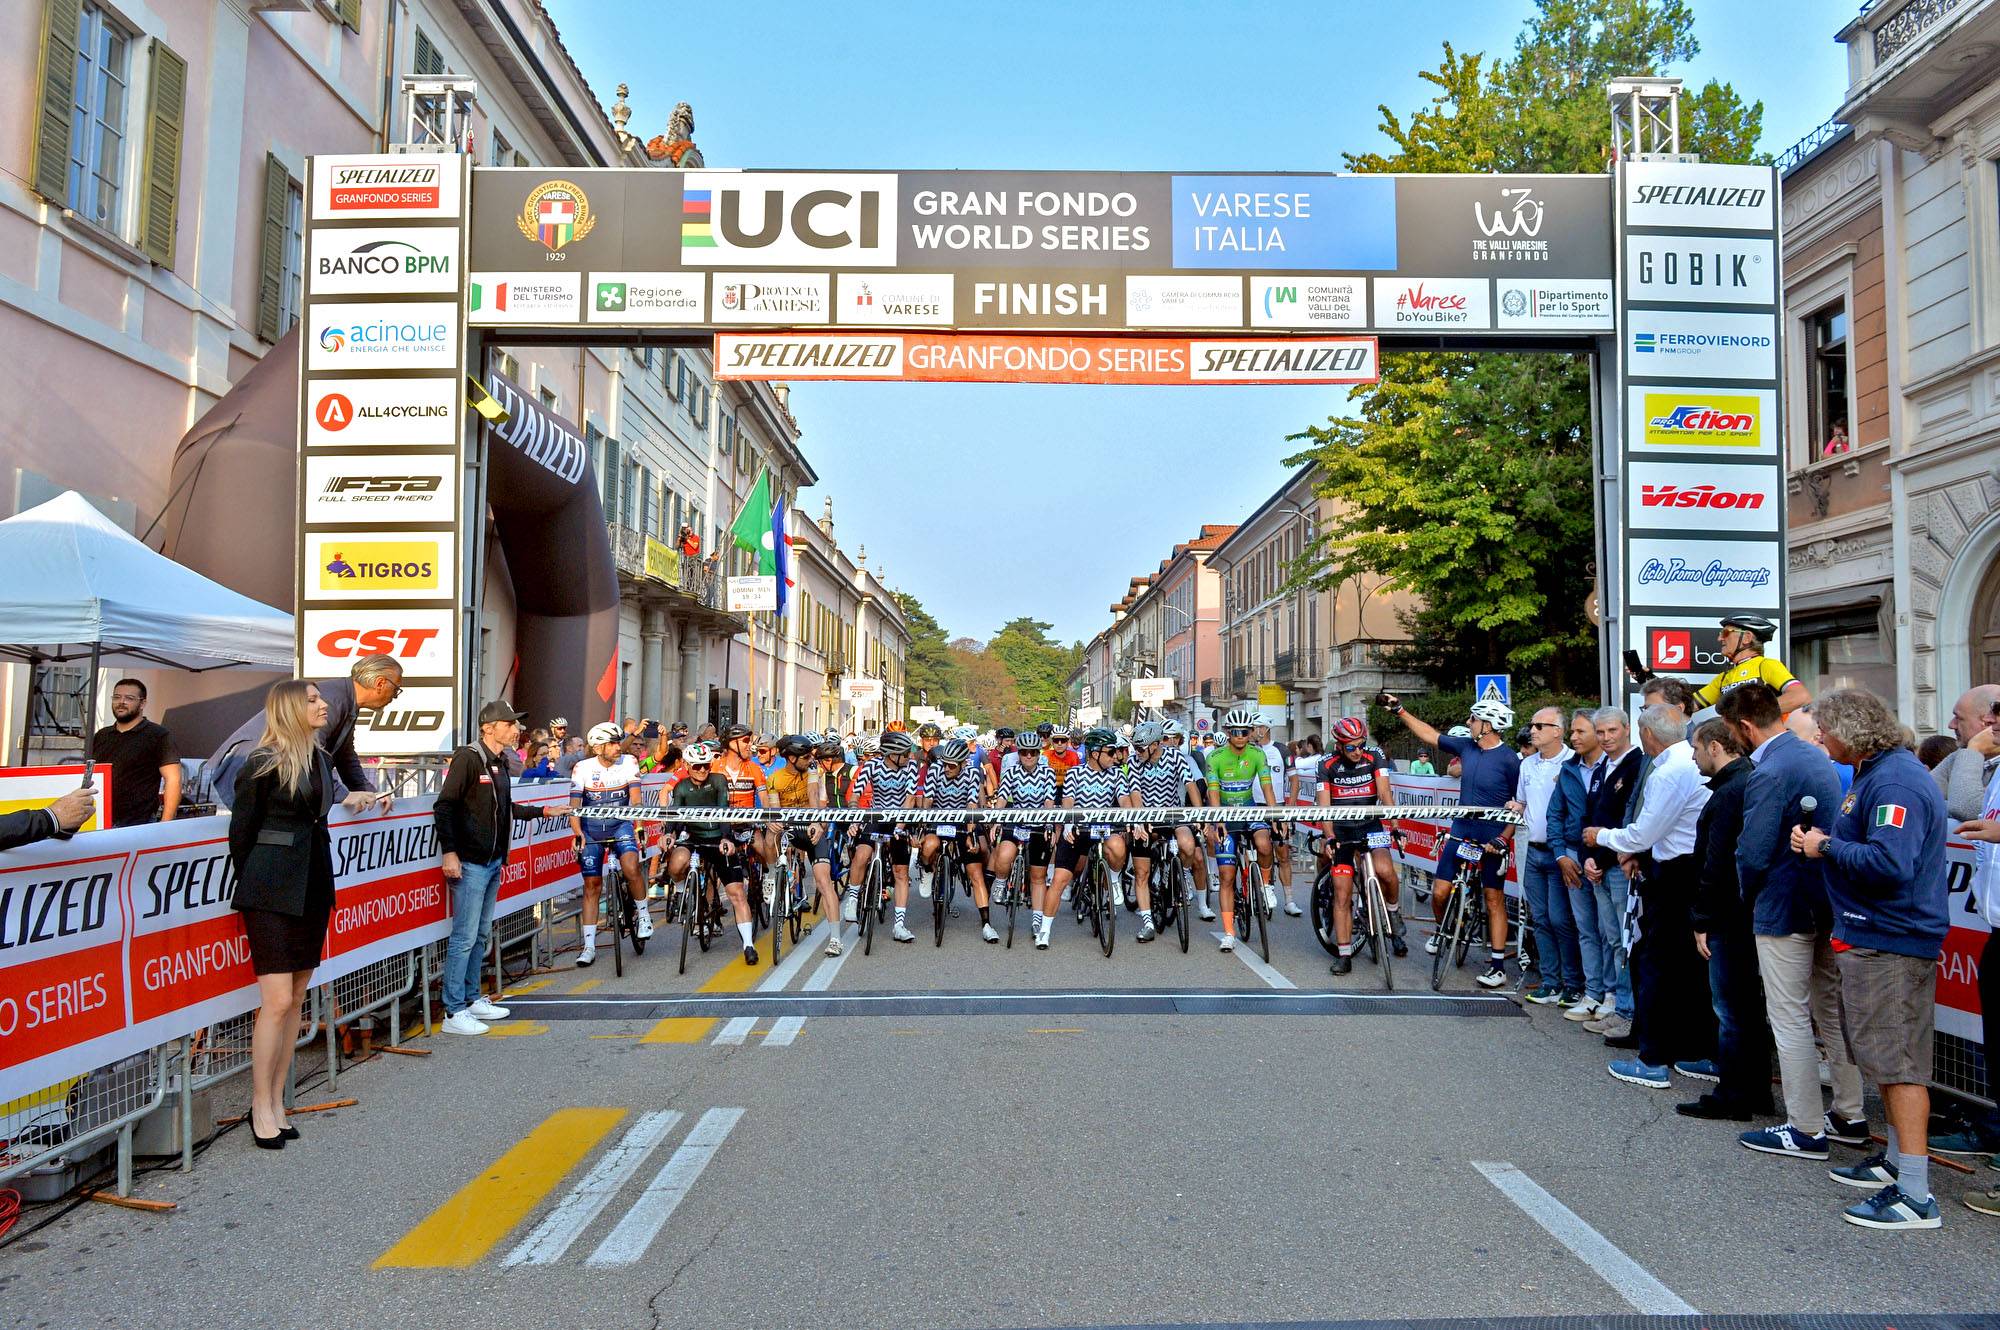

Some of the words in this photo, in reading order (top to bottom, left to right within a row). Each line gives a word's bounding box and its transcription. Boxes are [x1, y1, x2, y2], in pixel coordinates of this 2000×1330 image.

[335, 168, 435, 185] SPECIALIZED
[335, 193, 399, 204] GRANFONDO
[401, 192, 432, 203] SERIES
[543, 192, 571, 200] VARESE
[912, 191, 1013, 217] GRAN
[1018, 192, 1138, 217] FONDO
[1632, 185, 1766, 208] SPECIALIZED
[1192, 192, 1311, 219] VARESE
[720, 189, 880, 249] UCI
[912, 225, 1034, 251] WORLD
[1040, 225, 1151, 251] SERIES
[1193, 226, 1286, 252] ITALIA
[1473, 240, 1487, 250] TRE
[1489, 240, 1510, 250] VALLI
[1512, 240, 1548, 250] VARESINE
[545, 252, 566, 261] 1929
[1473, 251, 1549, 260] GRANFONDO
[319, 256, 399, 275] BANCO
[405, 256, 449, 274] BPM
[1639, 251, 1748, 287] GOBIK
[513, 293, 531, 301] DEL
[533, 293, 573, 301] TURISMO
[630, 287, 682, 299] Regione
[974, 283, 1108, 316] FINISH
[1396, 282, 1467, 310] #Varese
[1539, 290, 1609, 301] Dipartimento
[629, 298, 697, 308] Lombardia
[761, 299, 820, 312] VARESE
[883, 304, 940, 315] VARESE
[1539, 302, 1557, 312] per
[1559, 301, 1569, 311] lo
[1571, 301, 1601, 312] Sport
[350, 319, 447, 343] acinque
[350, 345, 388, 353] ENERGIA
[391, 345, 411, 353] CHE
[414, 344, 447, 352] UNISCE
[1660, 333, 1771, 347] FERROVIENORD
[727, 343, 896, 368] SPECIALIZED
[908, 345, 1091, 372] GRANFONDO
[1097, 348, 1185, 373] SERIES
[1198, 348, 1368, 372] SPECIALIZED
[358, 405, 448, 418] ALL4CYCLING
[318, 495, 346, 503] FULL
[351, 494, 390, 502] SPEED
[394, 494, 433, 502] AHEAD
[358, 562, 432, 578] TIGROS
[1638, 558, 1665, 585] Ciclo
[1664, 558, 1702, 583] Promo
[1702, 559, 1771, 588] Components
[316, 628, 440, 658] CST
[1333, 773, 1372, 785] CASSINIS
[676, 807, 764, 821] SPECIALIZED
[777, 808, 865, 822] SPECIALIZED
[878, 809, 967, 823] SPECIALIZED
[979, 809, 1067, 823] SPECIALIZED
[1079, 808, 1167, 823] SPECIALIZED
[1179, 808, 1267, 823] SPECIALIZED
[1279, 807, 1367, 821] SPECIALIZED
[335, 892, 406, 934] GRANFONDO
[408, 883, 440, 913] SERIES
[143, 935, 252, 992] GRANFOND
[25, 972, 107, 1029] SERIES
